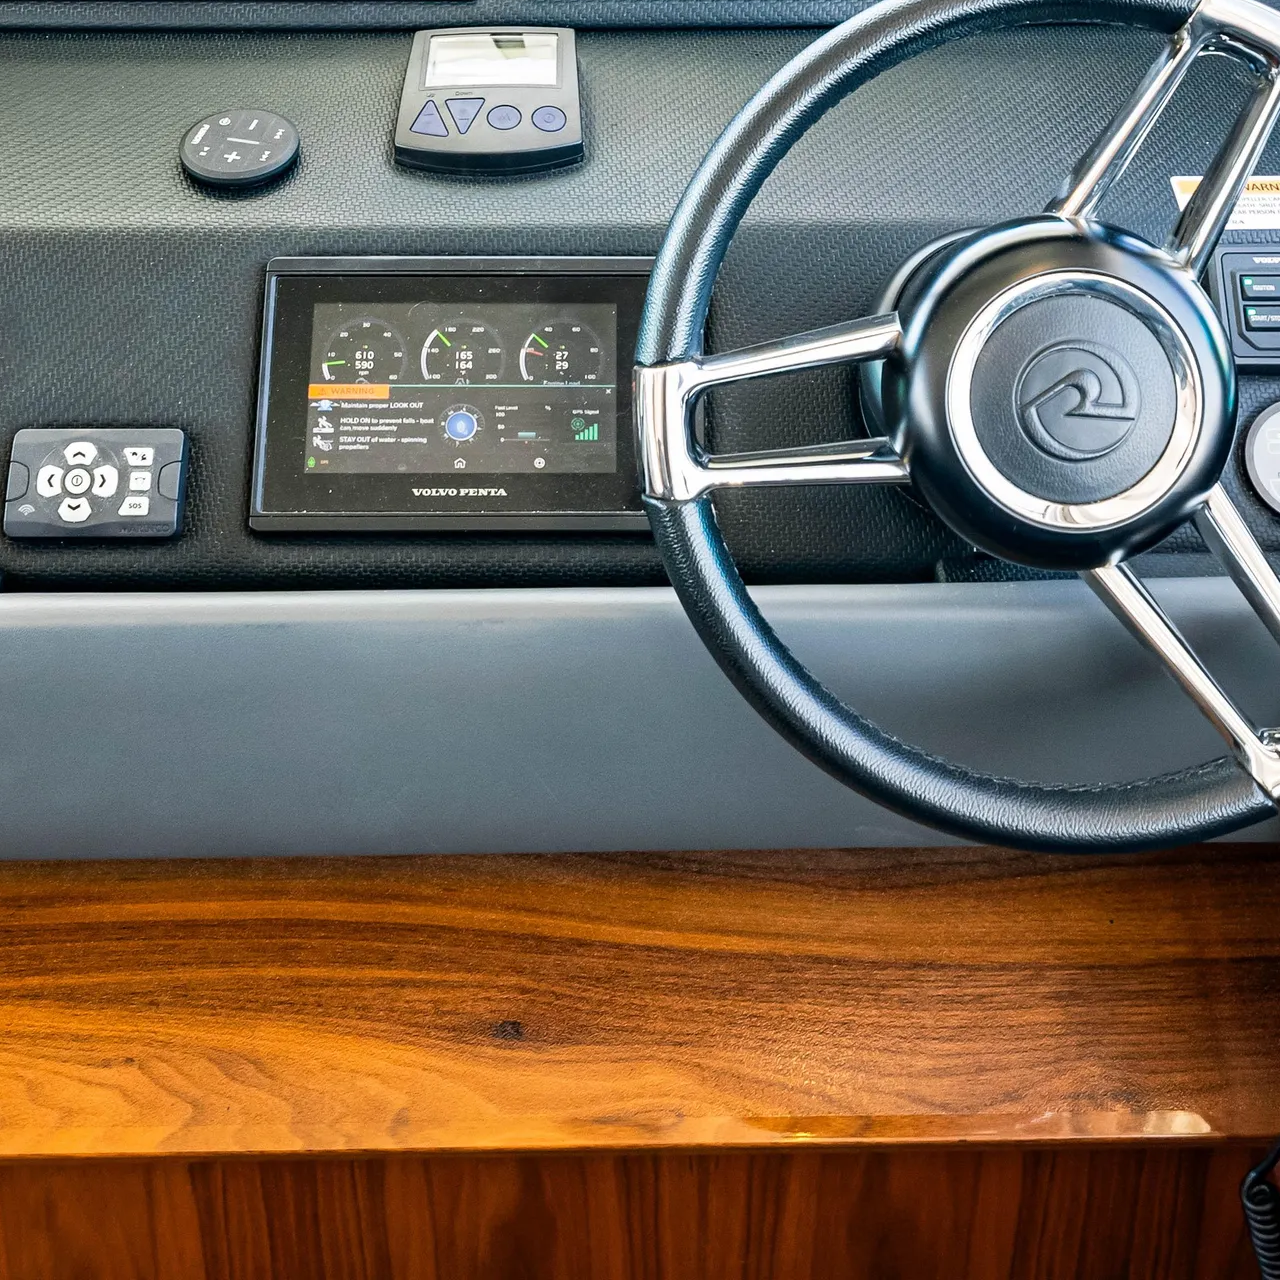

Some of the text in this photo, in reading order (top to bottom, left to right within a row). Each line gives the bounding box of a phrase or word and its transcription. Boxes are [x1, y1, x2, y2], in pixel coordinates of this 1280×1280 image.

[355, 351, 374, 359] 610
[355, 361, 374, 369] 590
[411, 488, 508, 496] VOLVO PENTA
